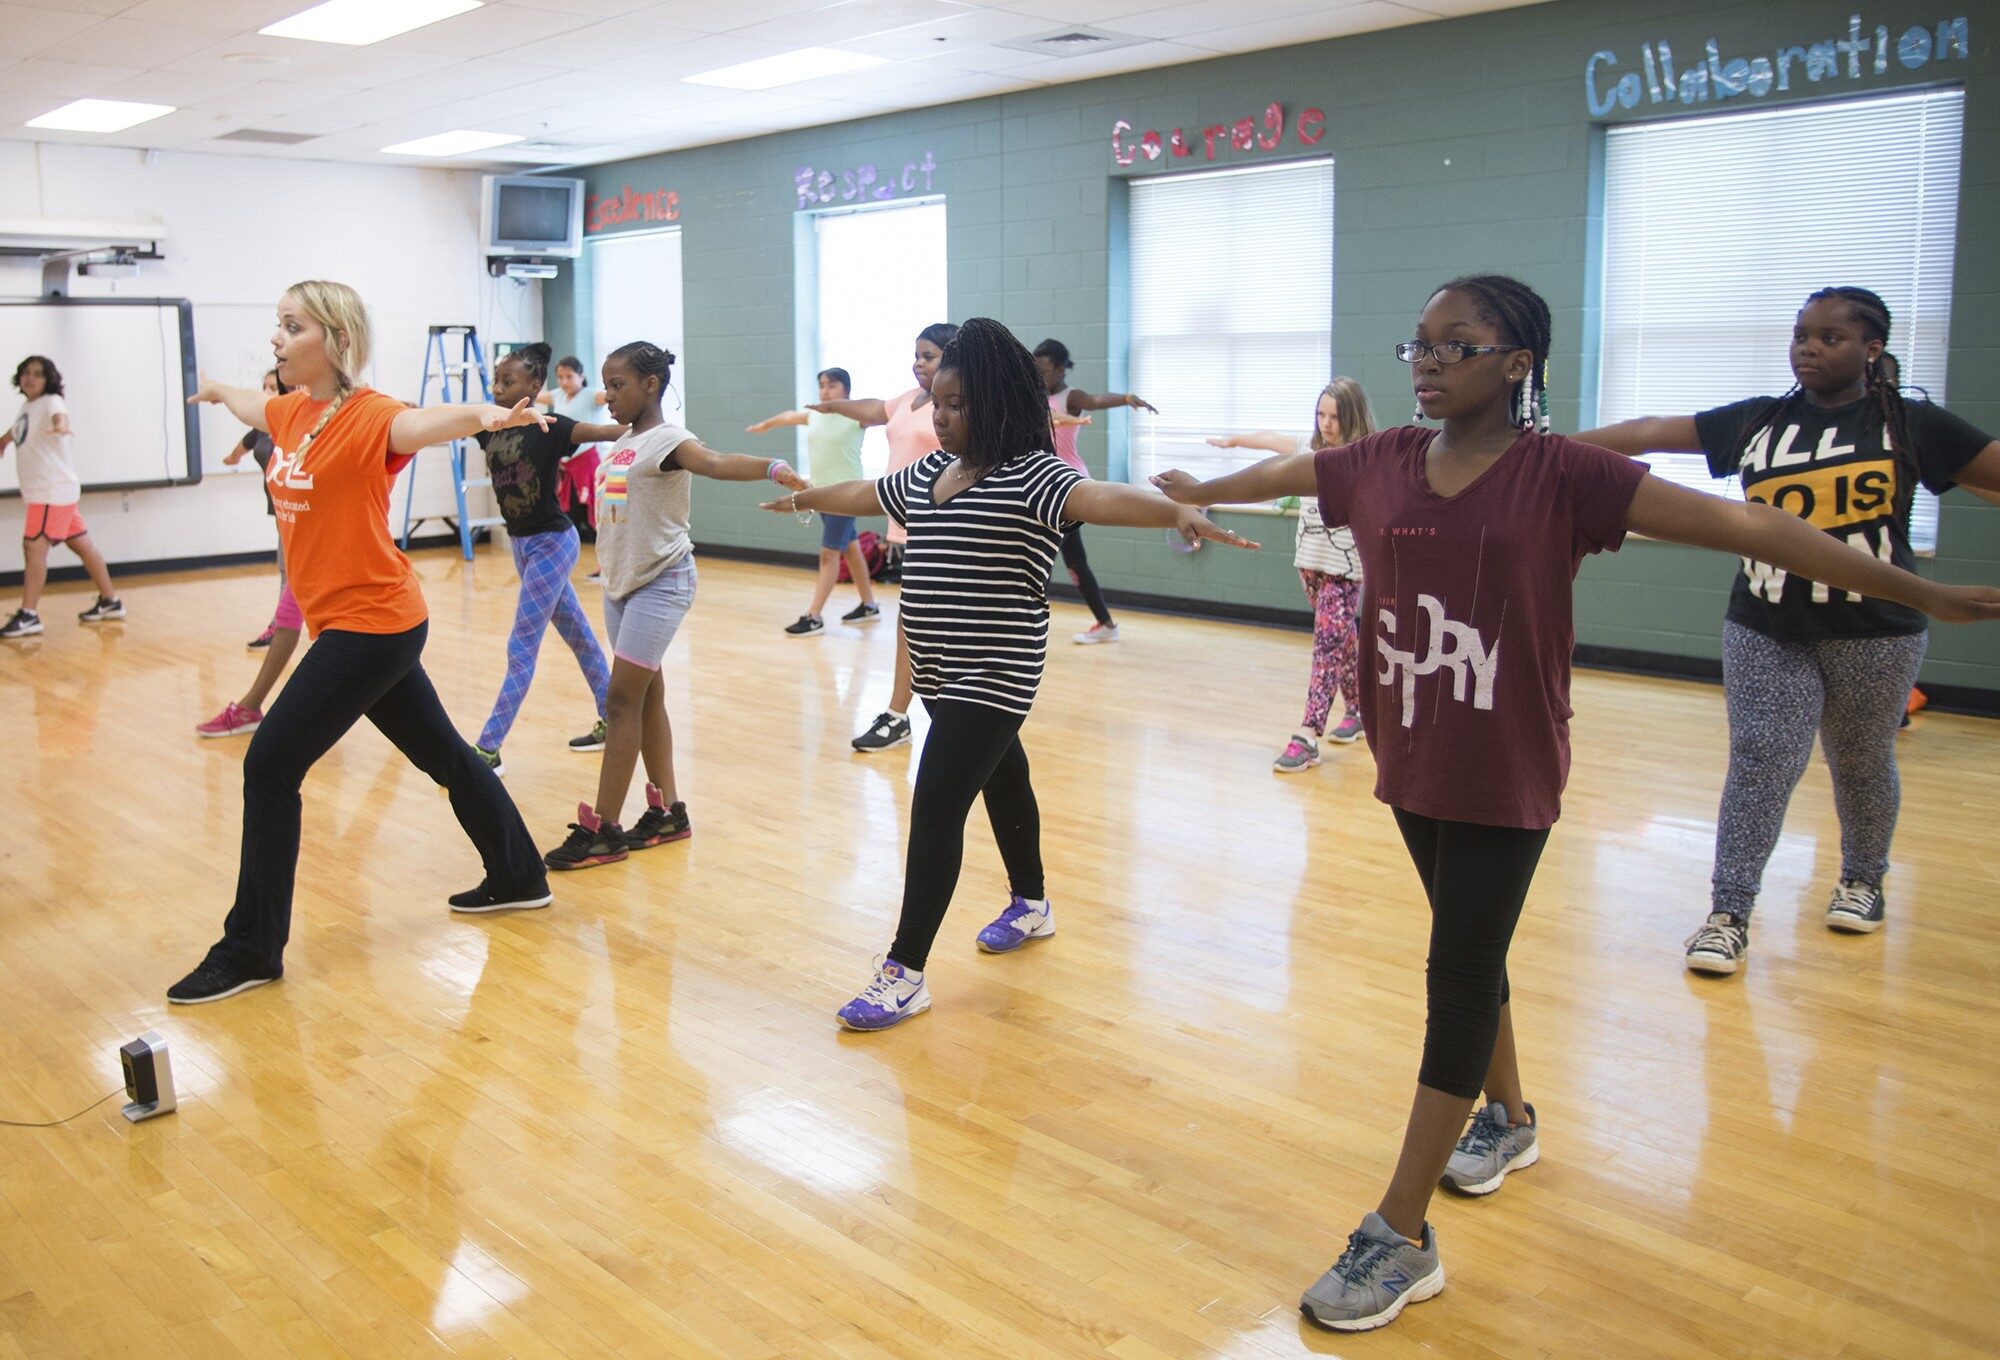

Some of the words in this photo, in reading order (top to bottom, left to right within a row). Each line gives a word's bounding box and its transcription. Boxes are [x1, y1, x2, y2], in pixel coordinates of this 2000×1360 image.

[1584, 12, 1969, 118] Collaboration
[1739, 423, 1856, 473] ALL
[1749, 483, 1816, 521] O
[1835, 470, 1891, 516] IS
[1392, 527, 1436, 536] WHAT'S
